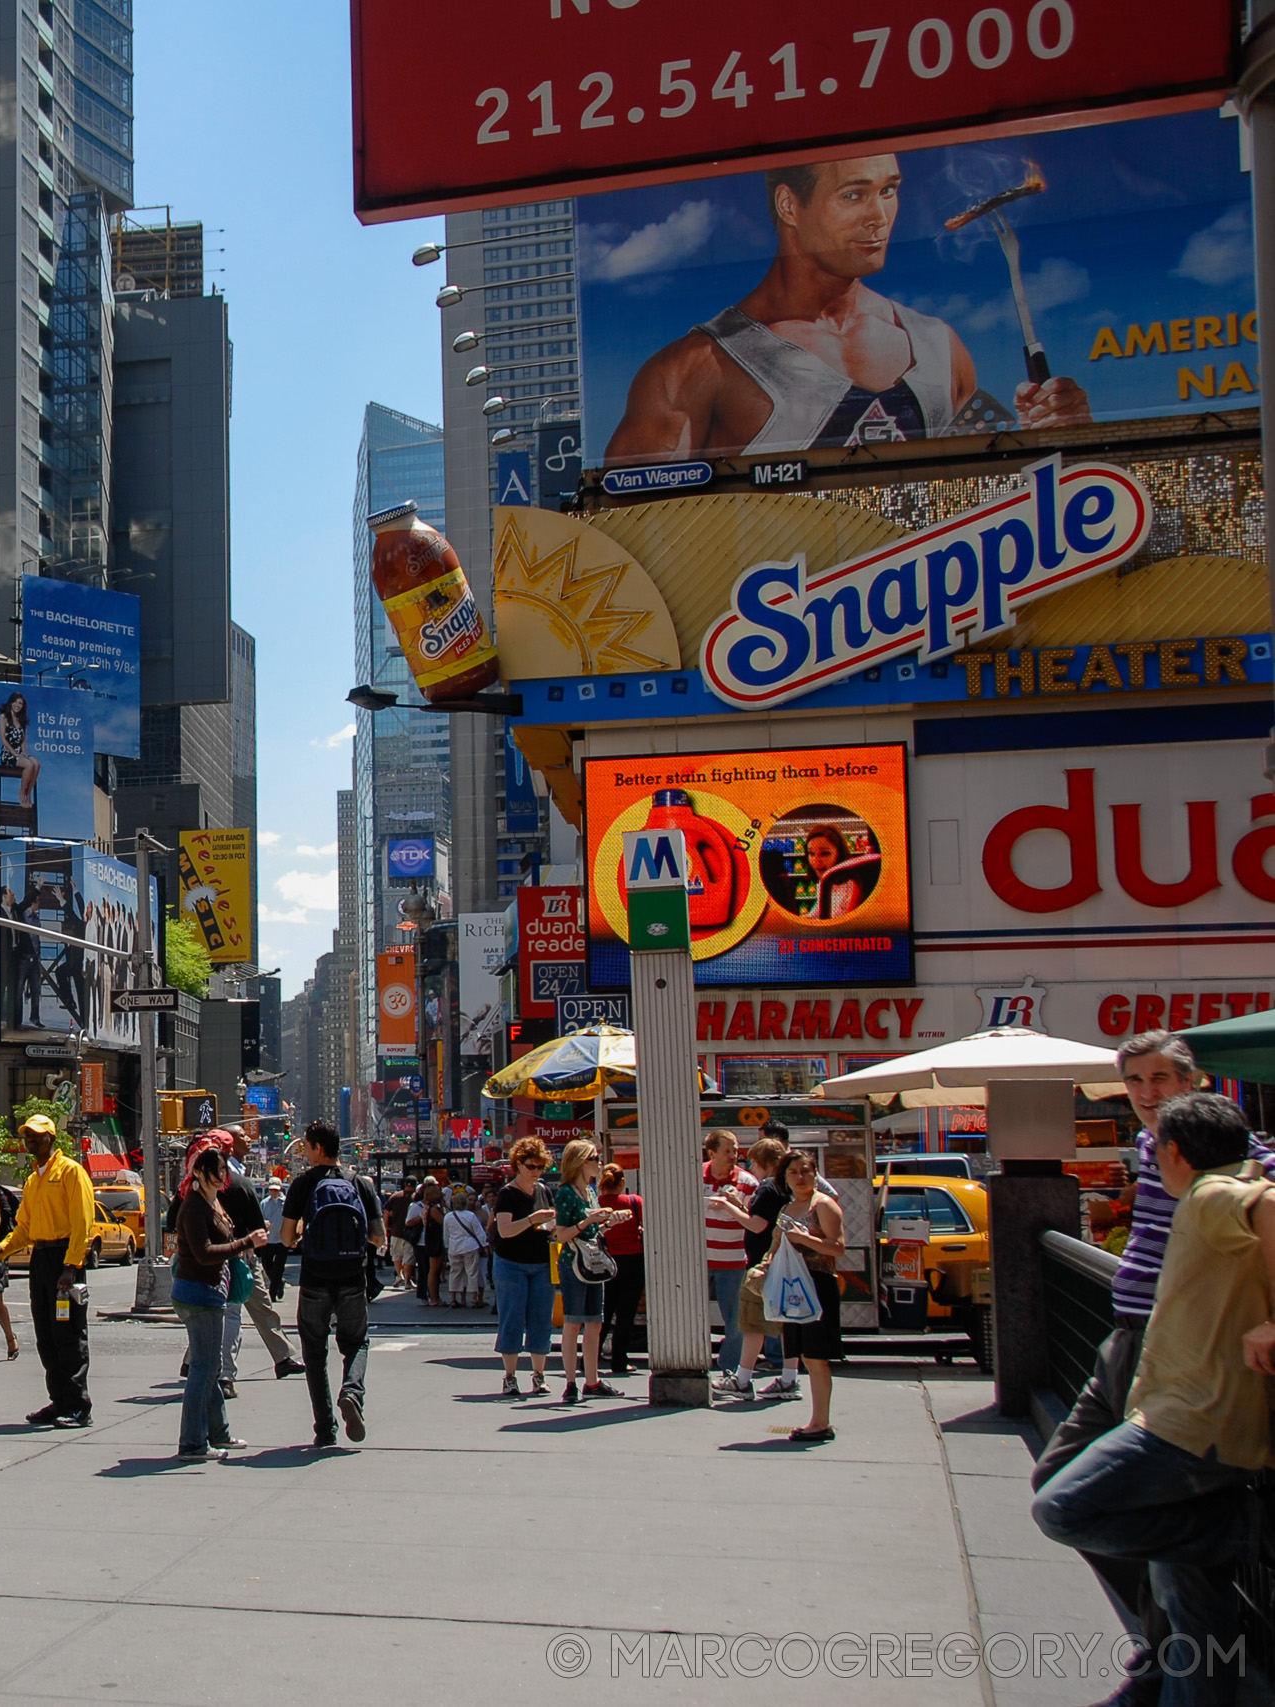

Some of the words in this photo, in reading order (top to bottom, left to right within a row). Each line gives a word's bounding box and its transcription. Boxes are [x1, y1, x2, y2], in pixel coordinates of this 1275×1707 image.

[475, 0, 1076, 145] 212.541.7000
[1177, 361, 1261, 401] NA
[615, 470, 644, 488] Van
[645, 467, 704, 486] Wagner
[754, 463, 803, 484] M-121
[727, 463, 1117, 688] Snapple
[30, 608, 45, 618] THE
[45, 611, 135, 637] BACHELORETTE
[42, 633, 76, 649] season
[79, 640, 122, 657] premiere
[26, 646, 65, 662] monday
[67, 653, 88, 668] may
[91, 656, 111, 671] 19th
[113, 659, 136, 675] 9/8c
[953, 637, 1249, 698] THEATER
[37, 711, 56, 725] it's
[58, 713, 81, 726] her
[37, 726, 64, 739] turn
[67, 728, 81, 741] to
[34, 740, 85, 755] choose.
[614, 772, 662, 787] Better
[666, 769, 707, 785] stain
[711, 766, 778, 784] fighting
[781, 763, 820, 780] than
[824, 762, 879, 777] before
[733, 816, 763, 852] Use
[400, 848, 431, 860] TDK
[629, 836, 680, 881] M
[86, 861, 98, 876] THE
[778, 938, 795, 954] 2X
[799, 936, 892, 954] CONCENTRATED
[538, 965, 579, 978] OPEN
[538, 979, 580, 997] 24/7
[120, 996, 140, 1006] ONE
[148, 995, 170, 1005] WAY
[563, 1000, 624, 1020] OPEN
[696, 997, 925, 1041] HARMACY
[918, 1030, 946, 1039] WITHIN
[535, 1126, 552, 1137] The
[550, 1126, 572, 1140] Jerry
